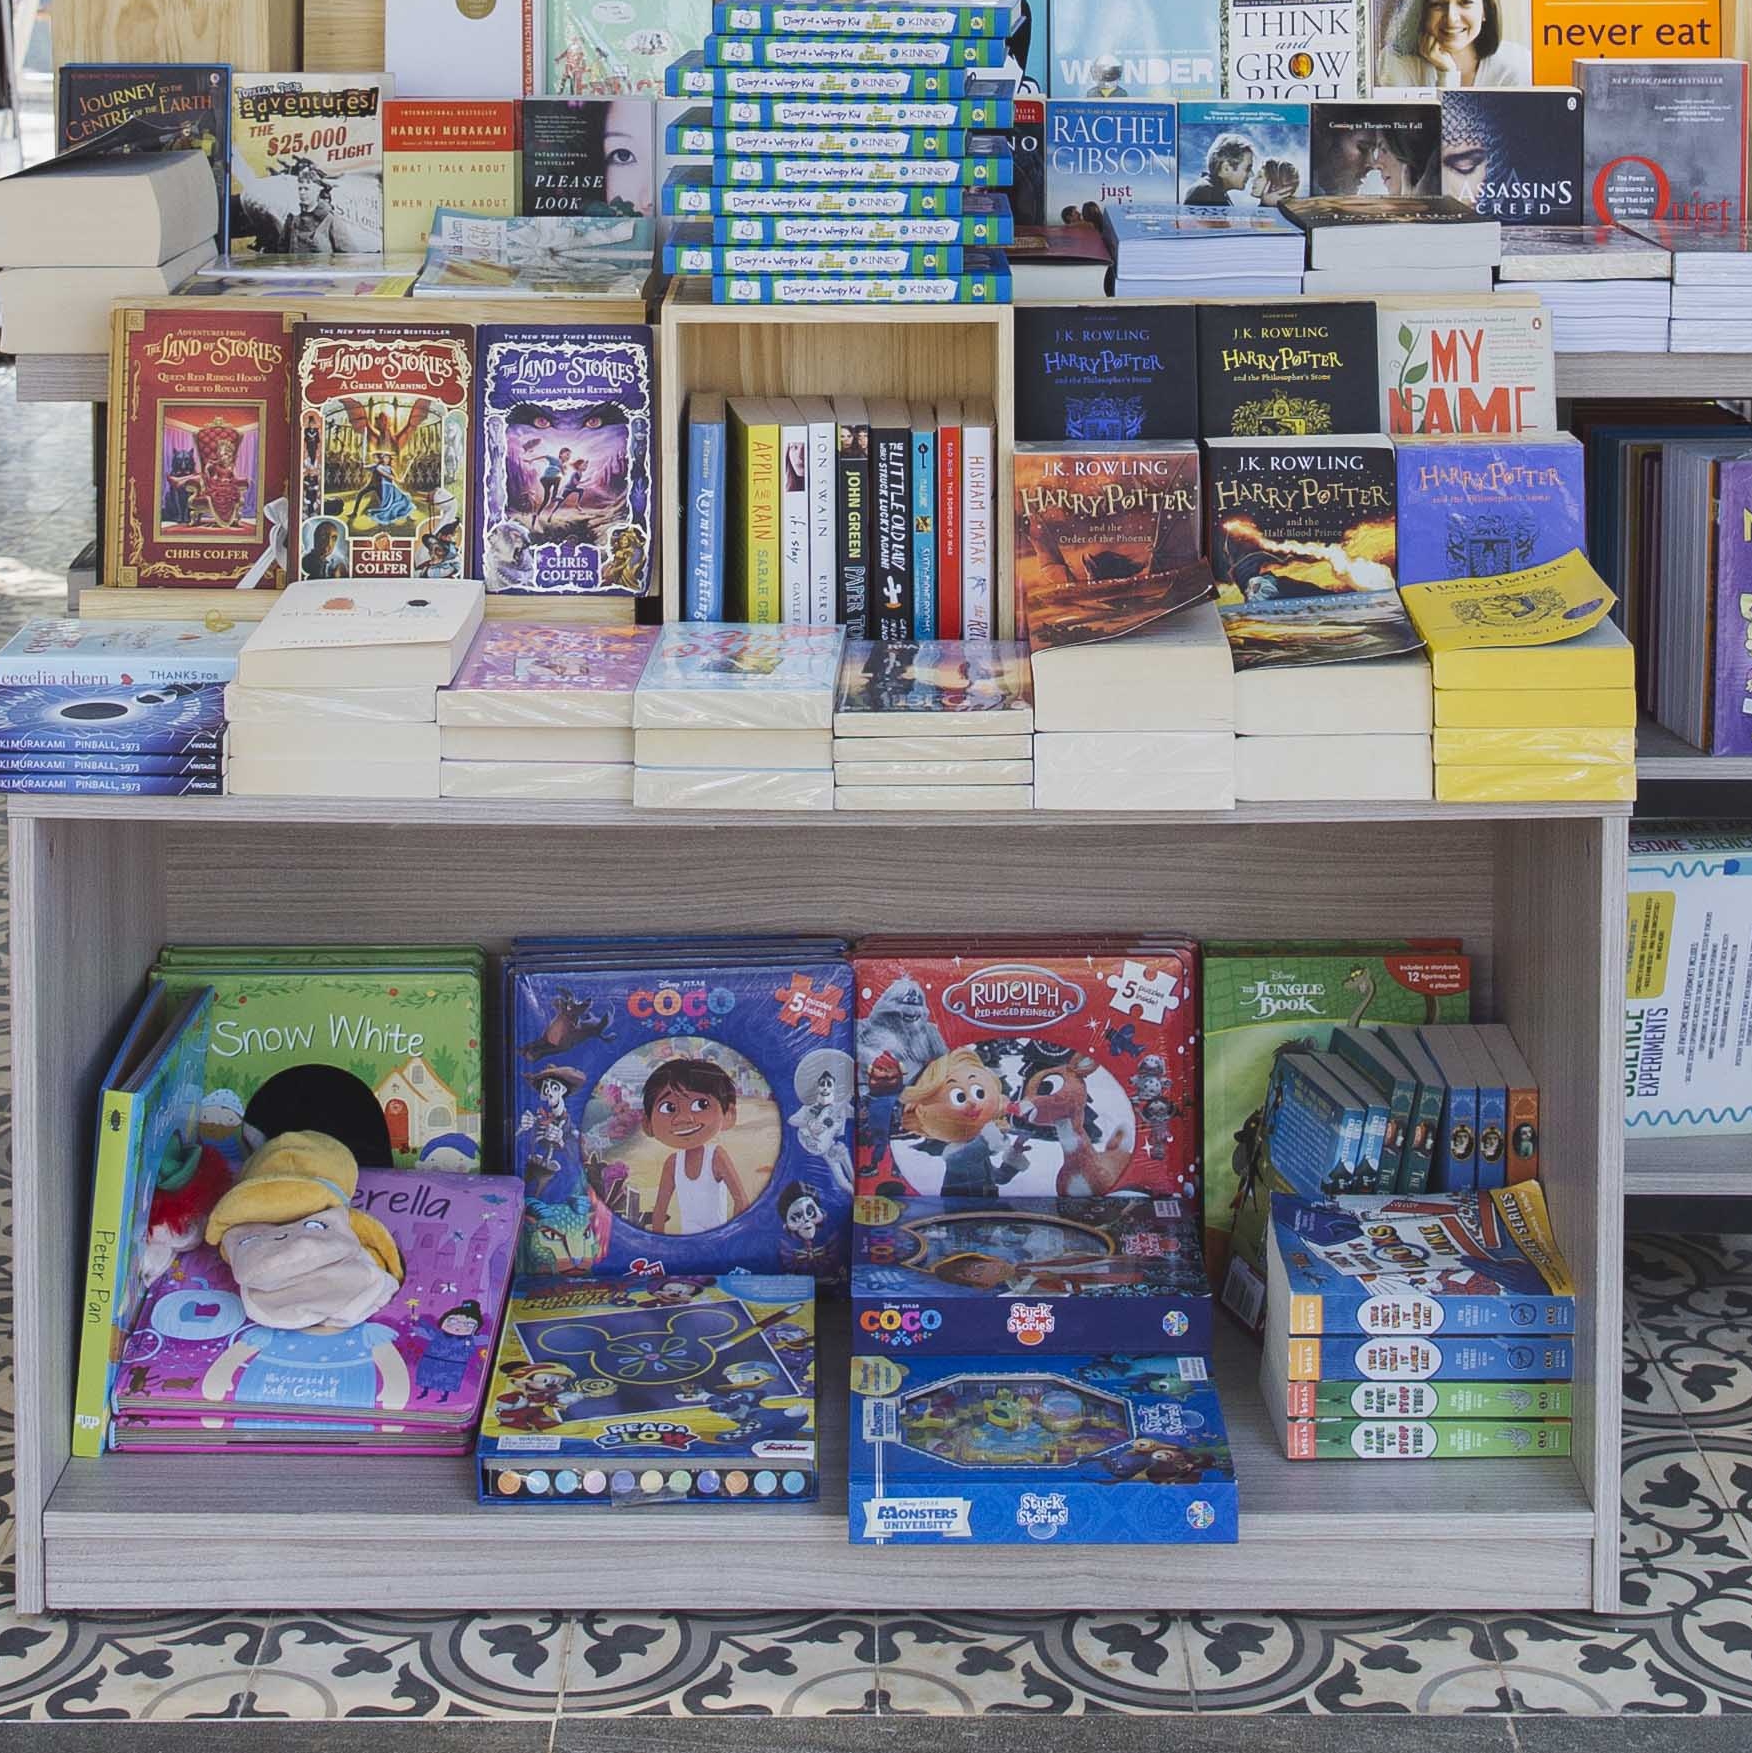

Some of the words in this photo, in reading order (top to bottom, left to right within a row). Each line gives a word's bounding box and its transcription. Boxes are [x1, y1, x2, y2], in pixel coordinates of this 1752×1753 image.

[783, 15, 807, 28] Diary
[821, 16, 846, 28] Wimpy
[849, 15, 861, 26] Kid
[908, 17, 948, 27] KINNEY
[1235, 9, 1351, 38] THINK
[1543, 24, 1644, 46] never
[1656, 18, 1712, 46] eat
[1275, 33, 1317, 50] and
[1236, 51, 1351, 81] GROW
[79, 82, 156, 117] JOURNEY
[159, 94, 213, 115] EARTH
[243, 91, 378, 115] adventures!
[249, 122, 275, 138] THE
[390, 126, 436, 136] HARUKI
[442, 126, 507, 136] MURAKAMI
[1054, 115, 1173, 145] RACHEL
[267, 126, 347, 158] $25,000
[328, 144, 374, 162] FLIGHT
[1053, 148, 1172, 177] GIBSON
[535, 175, 605, 190] PLEASE
[1100, 183, 1133, 201] just
[1459, 180, 1572, 204] ASSASSIN'S
[535, 196, 583, 210] LOOK
[1475, 203, 1552, 216] CREED
[1055, 330, 1078, 342] J.K.
[1082, 329, 1150, 341] ROWLING
[1232, 328, 1257, 340] J.K.
[1261, 326, 1329, 339] ROWLING
[154, 333, 202, 366] LAND
[203, 342, 216, 351] OF
[210, 336, 283, 374] STORIES
[1043, 351, 1099, 374] HARRY
[1100, 350, 1165, 372] POTTER
[1222, 348, 1279, 371] HARRY
[1279, 347, 1344, 370] POTTER
[1431, 328, 1484, 384] MY
[817, 433, 828, 469] JON
[1042, 461, 1070, 477] J.K.
[1074, 459, 1169, 476] ROWLING
[1236, 457, 1266, 473] J.K.
[1270, 455, 1364, 471] ROWLING
[845, 470, 861, 508] JOHN
[889, 451, 906, 511] LITTLE
[969, 455, 986, 511] HISHAM
[1021, 485, 1101, 519] HARRY
[1102, 483, 1197, 516] POTTER
[1215, 479, 1297, 512] HARRY
[1297, 478, 1392, 510] POTTER
[817, 479, 828, 538] SWAIN
[848, 511, 862, 558] GREEN
[890, 514, 906, 542] OLD
[1264, 528, 1311, 538] Half-Blood
[1313, 527, 1343, 537] Prince
[165, 548, 203, 561] CHRIS
[206, 548, 249, 561] COLFER
[361, 550, 403, 563] CHRIS
[547, 556, 590, 569] CHRIS
[889, 543, 907, 572] LADY
[355, 563, 409, 575] COLFER
[541, 569, 593, 583] COLFER
[694, 551, 712, 623] Nighting
[818, 575, 828, 609] RIVER
[845, 565, 865, 613] PAPER
[1, 670, 56, 686] cecelia
[61, 670, 109, 686] ahern
[149, 670, 198, 680] THANKS
[201, 672, 219, 680] FOR
[10, 739, 66, 749] MURAKAMI
[75, 741, 119, 751] PINBALL,
[120, 742, 140, 751] 1973
[1629, 839, 1688, 853] ESOME
[1270, 969, 1296, 982] Disney
[627, 987, 736, 1018] COCO
[788, 991, 804, 1013] 5
[970, 981, 1060, 1009] RUDOLPH
[1251, 982, 1327, 1005] JUNGLE
[1251, 994, 1327, 1020] BOOK
[211, 1020, 316, 1057] Snow
[329, 1013, 425, 1057] White
[1637, 1007, 1668, 1097] EXPERIMENTS
[348, 1184, 451, 1219] erella
[87, 1229, 117, 1285] Peter
[87, 1288, 111, 1324] Pan
[1011, 1303, 1054, 1320] Stuck
[859, 1309, 943, 1332] COCO
[1008, 1316, 1055, 1333] Stories
[596, 1431, 698, 1449] GLOW
[877, 1505, 958, 1520] MONSTERS
[1020, 1493, 1065, 1510] Stuck
[883, 1519, 954, 1530] UNIVERSITY
[1017, 1507, 1068, 1526] Stories
